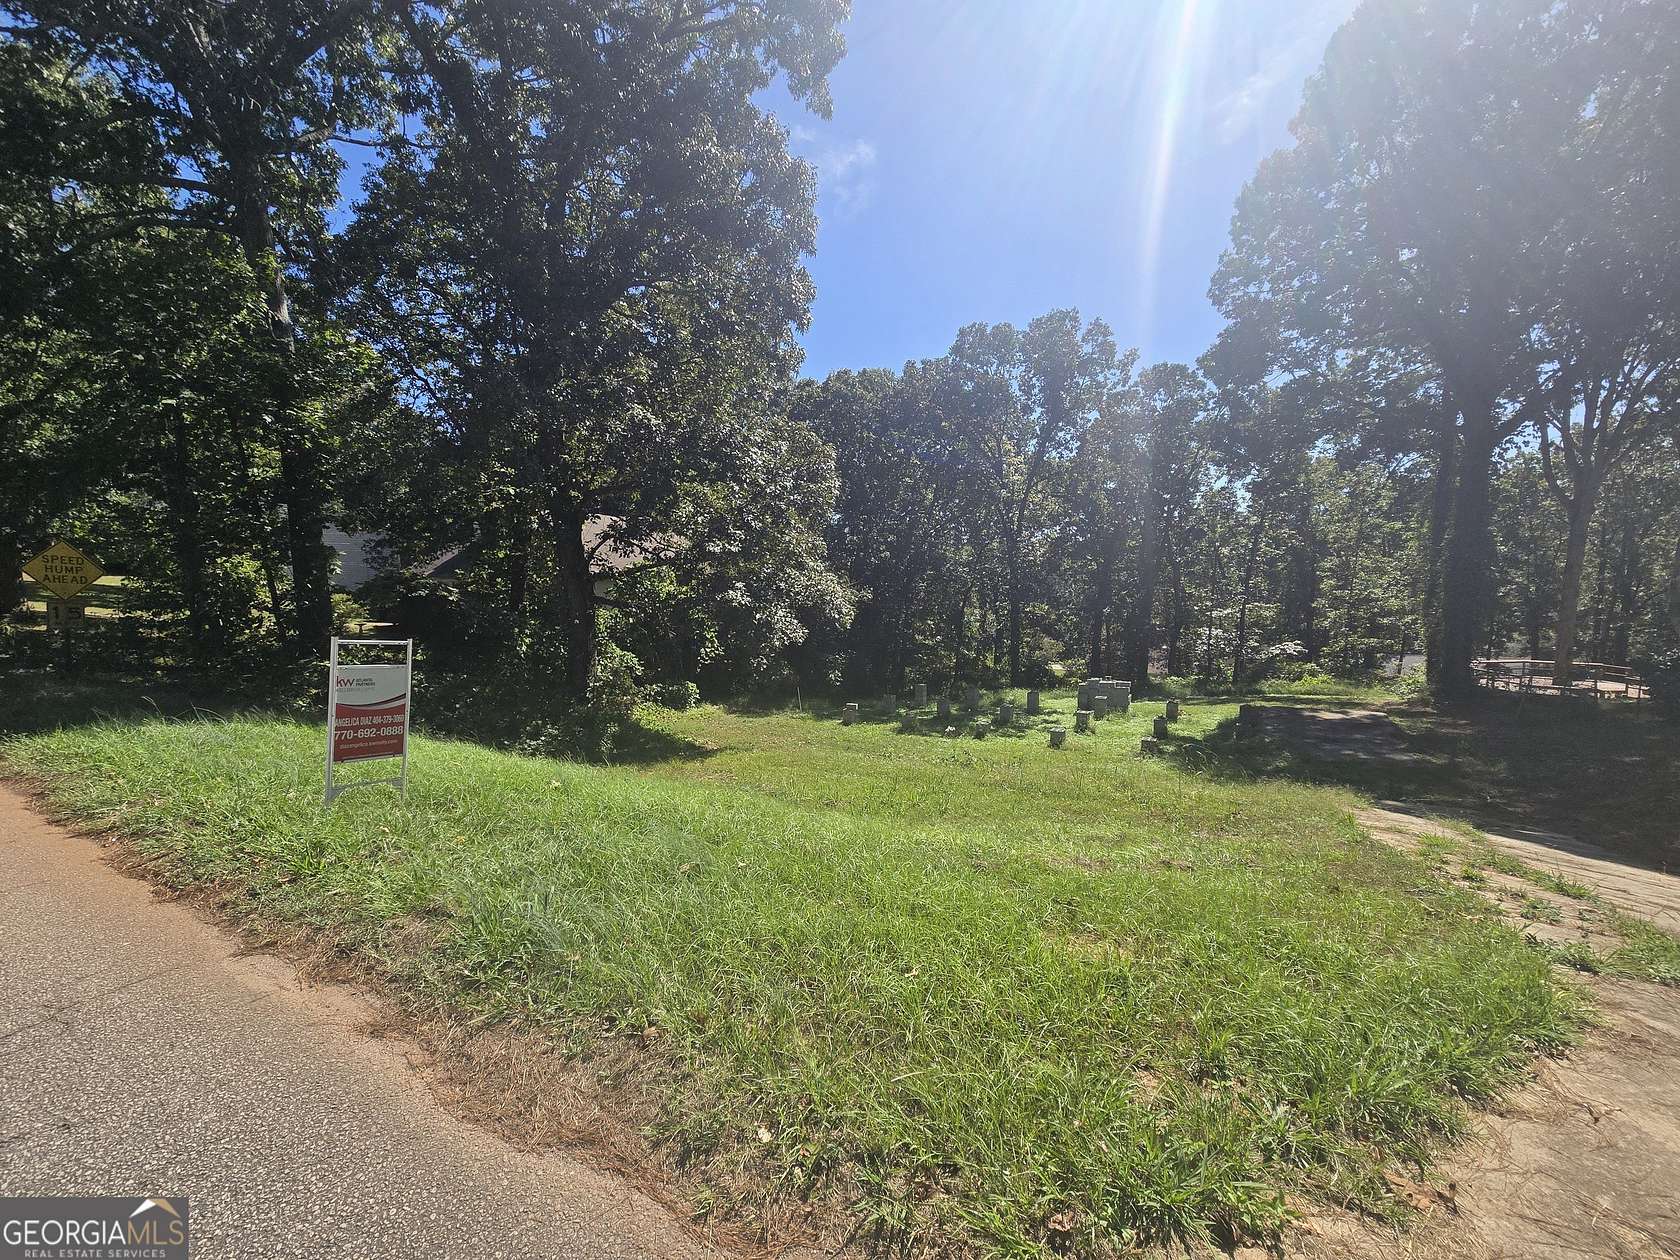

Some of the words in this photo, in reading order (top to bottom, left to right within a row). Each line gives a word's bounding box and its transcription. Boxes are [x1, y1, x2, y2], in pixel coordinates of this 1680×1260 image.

[42, 555, 84, 566] SPEED
[44, 565, 82, 575] HUMP
[43, 574, 88, 585] AHEAD
[336, 675, 355, 688] kw
[335, 716, 360, 727] ANGELICA
[360, 715, 372, 726] DIAZ
[334, 725, 404, 740] 770-692-0888
